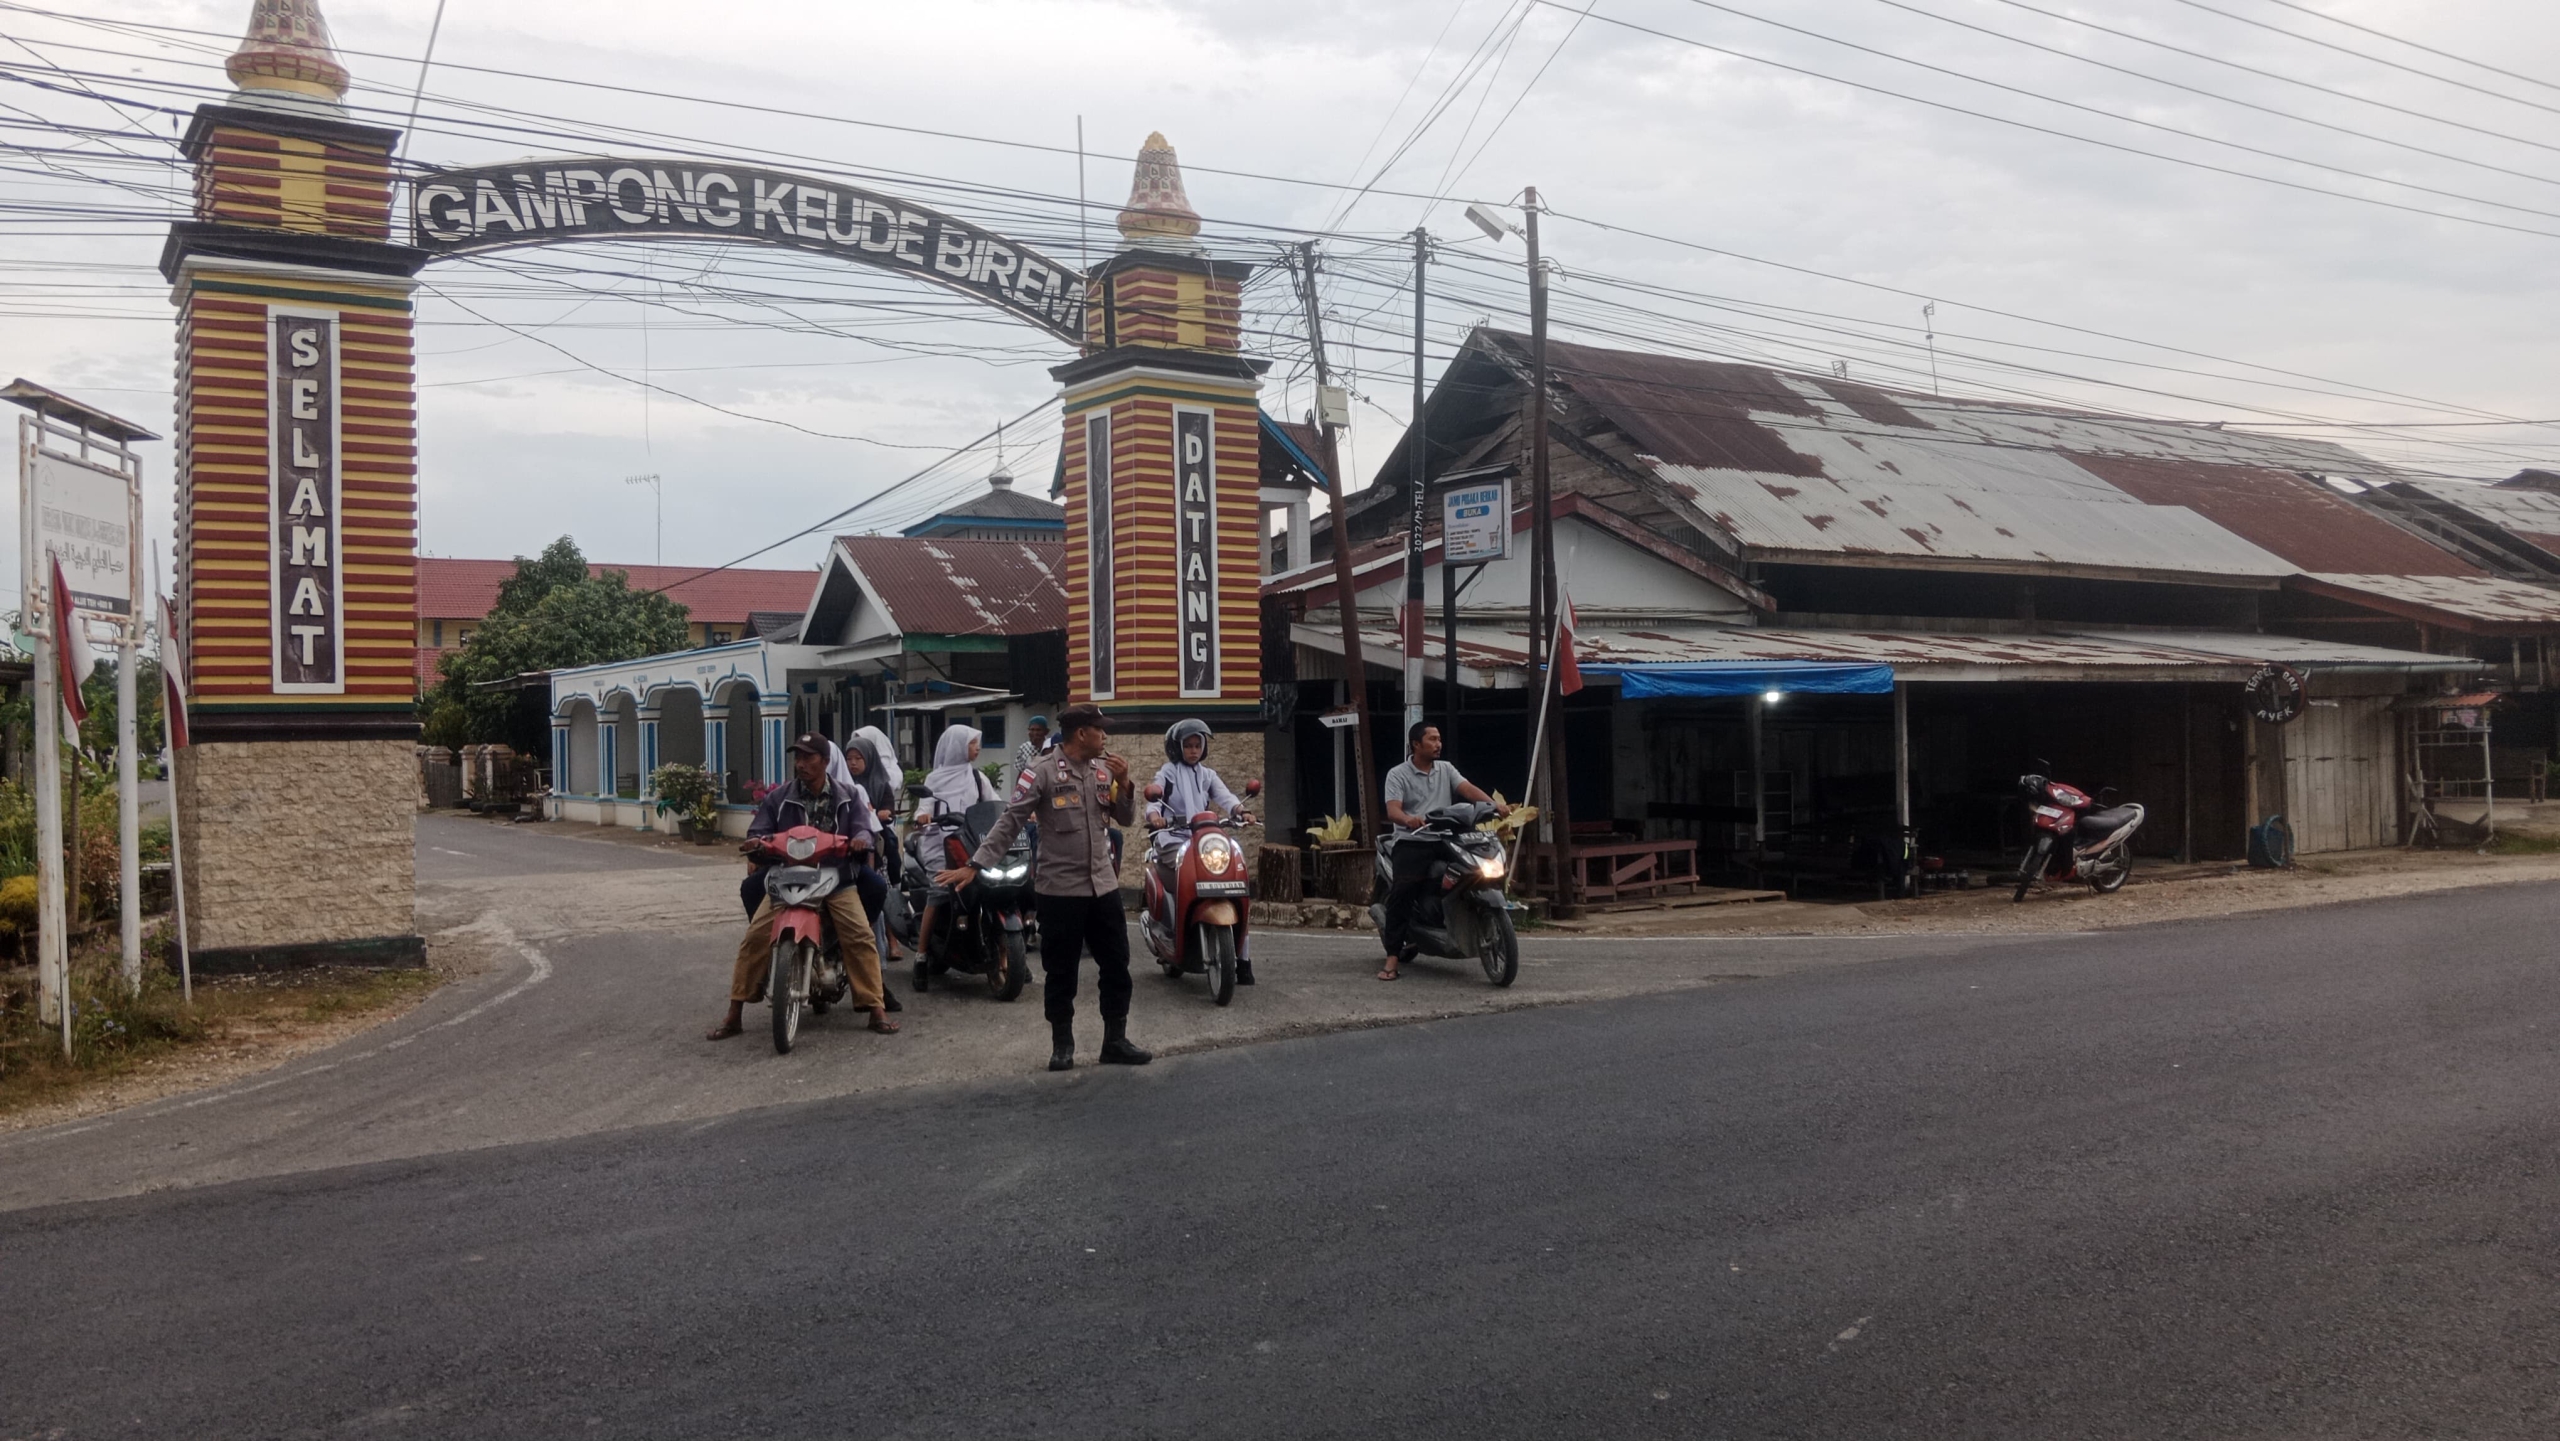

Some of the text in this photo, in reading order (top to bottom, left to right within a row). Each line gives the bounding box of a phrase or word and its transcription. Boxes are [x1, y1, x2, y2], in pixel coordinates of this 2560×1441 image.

[417, 167, 1086, 331] GAMPONG KEUDE BIREM
[288, 328, 328, 666] SELAMAT
[1184, 432, 1208, 663] DATANG
[1464, 508, 1481, 518] BUKA
[2245, 667, 2299, 692] TEMPEL BAN
